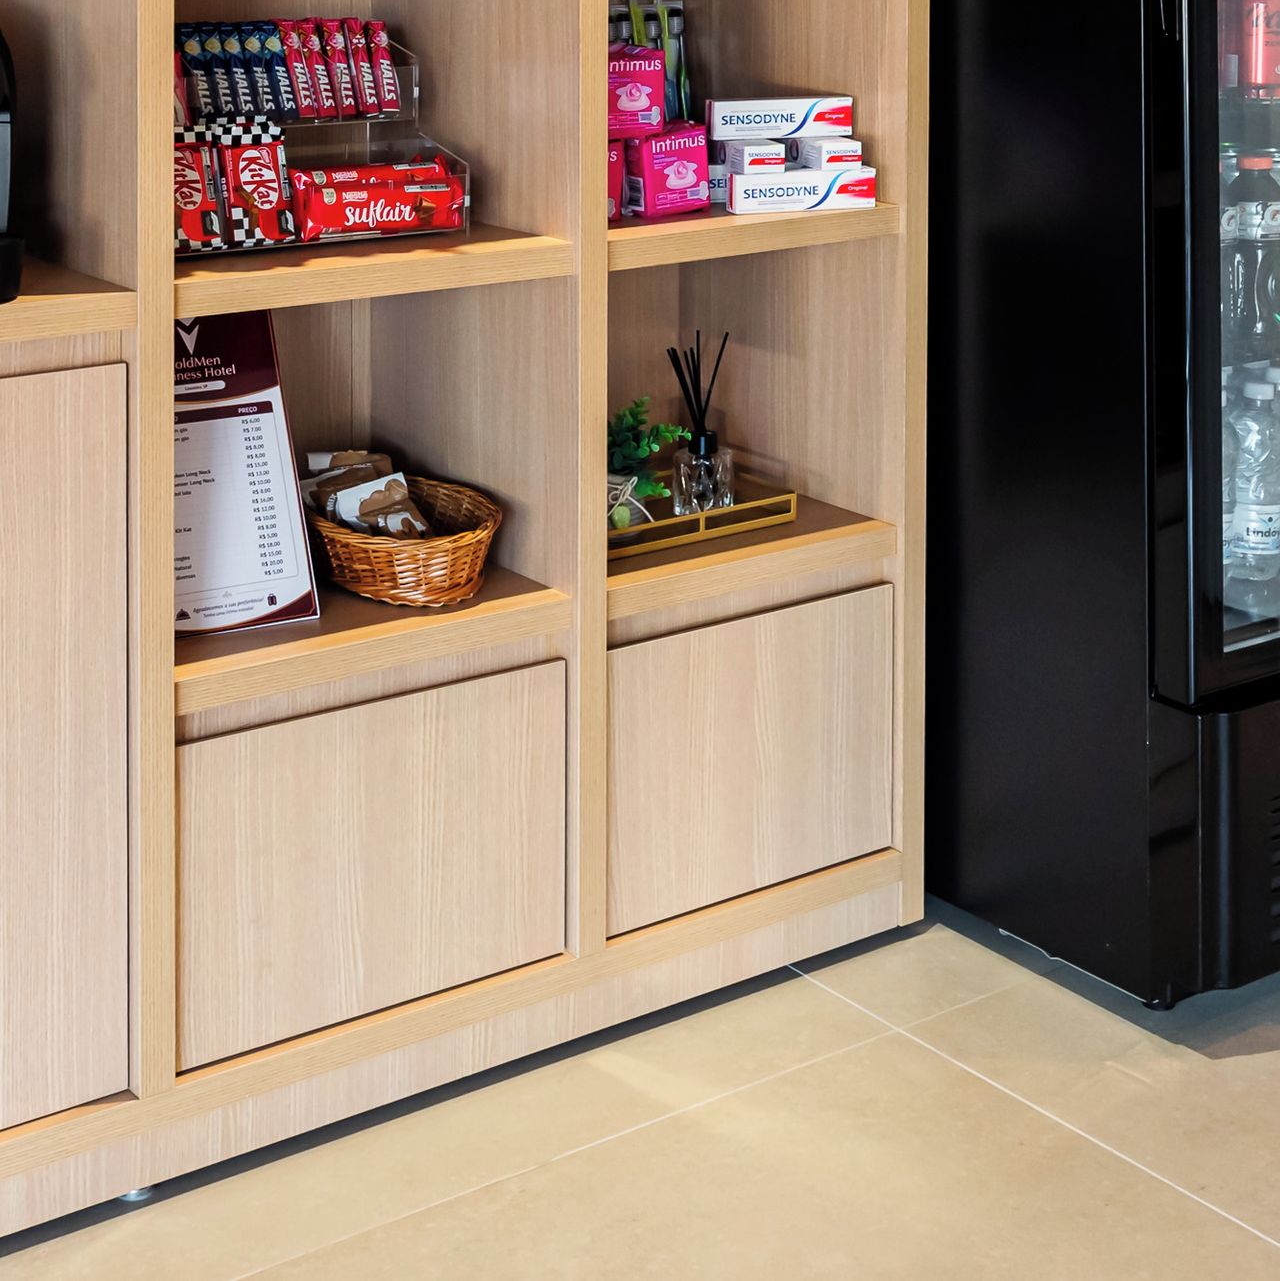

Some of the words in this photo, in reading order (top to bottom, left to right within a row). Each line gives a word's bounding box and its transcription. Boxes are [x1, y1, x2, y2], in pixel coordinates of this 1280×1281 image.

[721, 113, 796, 126] SENSODYNE
[652, 133, 706, 155] Intimus
[744, 185, 819, 199] SENSODYNE
[344, 198, 417, 228] suflair
[175, 356, 221, 370] oldMen
[204, 363, 236, 378] Hotel
[238, 406, 258, 414] PREÇO
